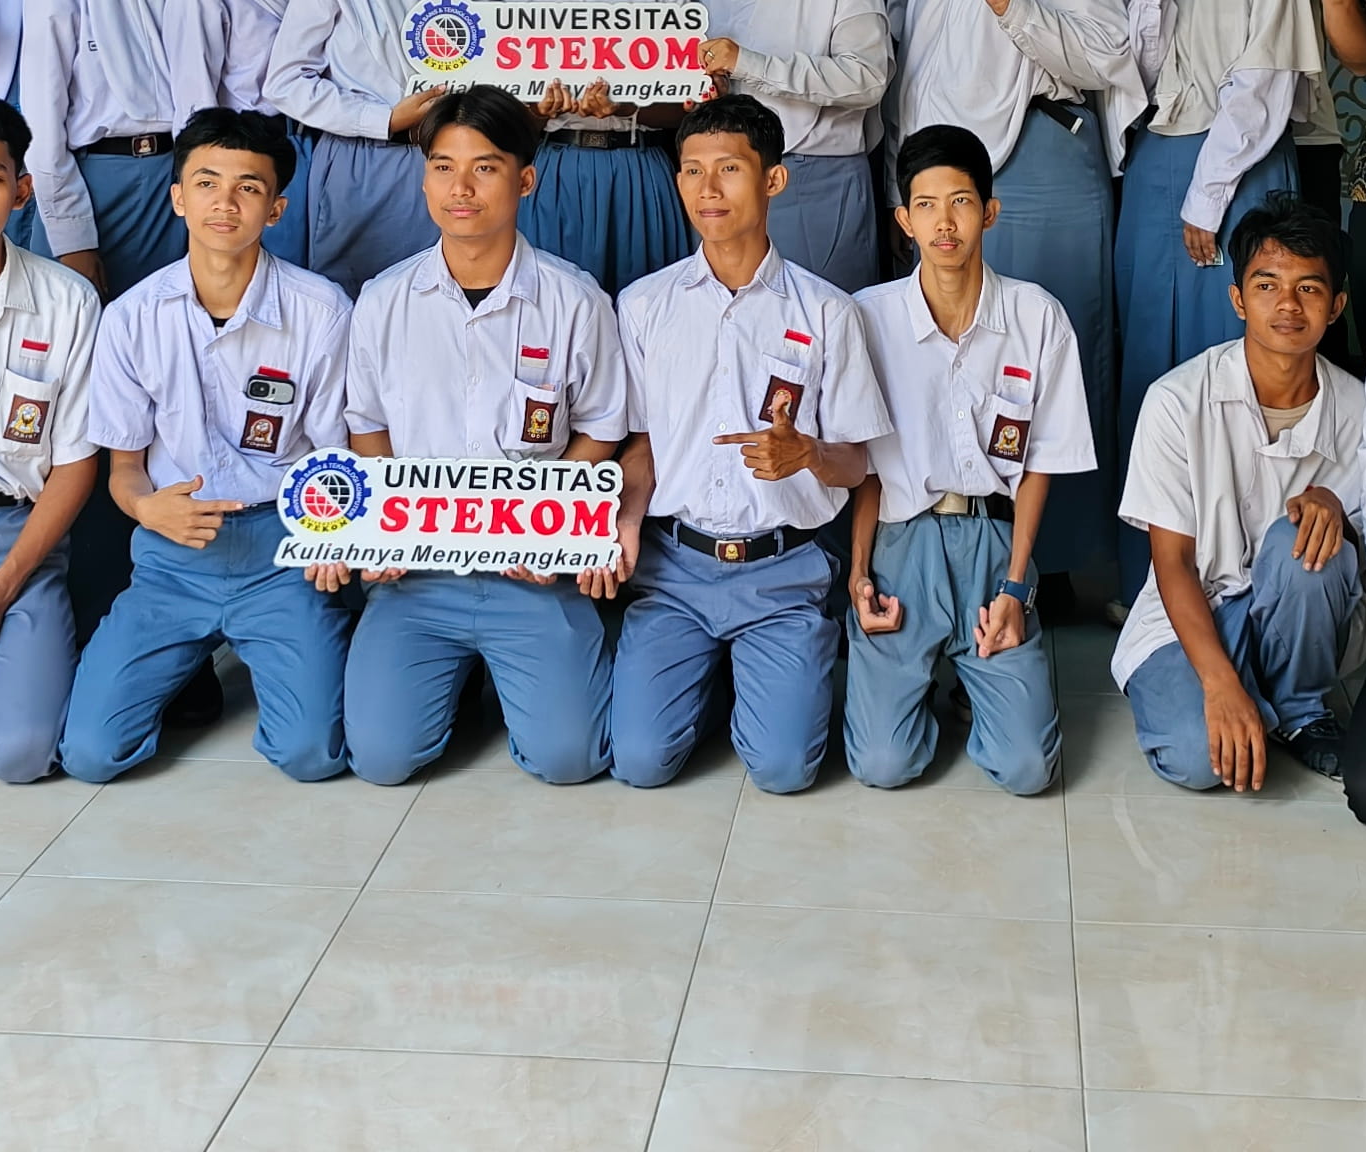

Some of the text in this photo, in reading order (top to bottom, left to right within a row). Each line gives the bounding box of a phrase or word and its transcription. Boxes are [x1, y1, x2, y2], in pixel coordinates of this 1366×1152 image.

[496, 8, 702, 30] UNIVERSITAS
[424, 58, 467, 71] STEKOM
[496, 36, 704, 71] STEKOM
[385, 464, 617, 493] UNIVERSITAS
[299, 518, 348, 532] STEKOM
[380, 496, 613, 537] STEKOM
[281, 542, 614, 570] Kuliahnya Menyenangkan !
